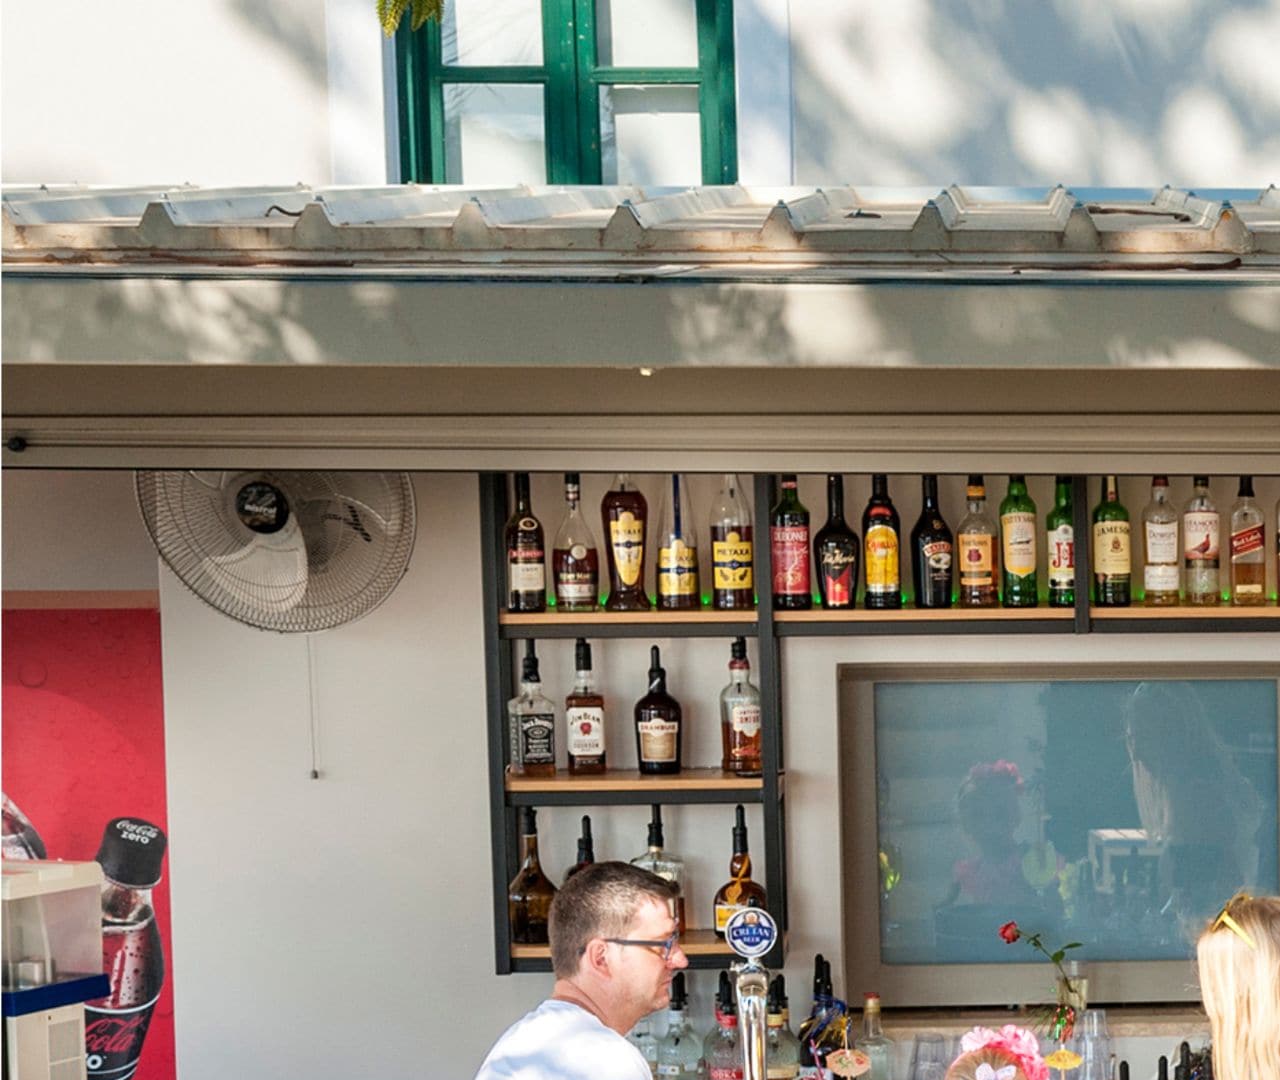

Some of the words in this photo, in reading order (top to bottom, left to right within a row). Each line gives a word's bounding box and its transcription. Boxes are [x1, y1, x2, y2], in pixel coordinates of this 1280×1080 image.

[1096, 527, 1130, 537] JAMESON
[716, 548, 751, 556] METAXA
[116, 819, 159, 839] Coca-Cola
[120, 831, 150, 845] zero
[732, 927, 770, 937] CRETAN
